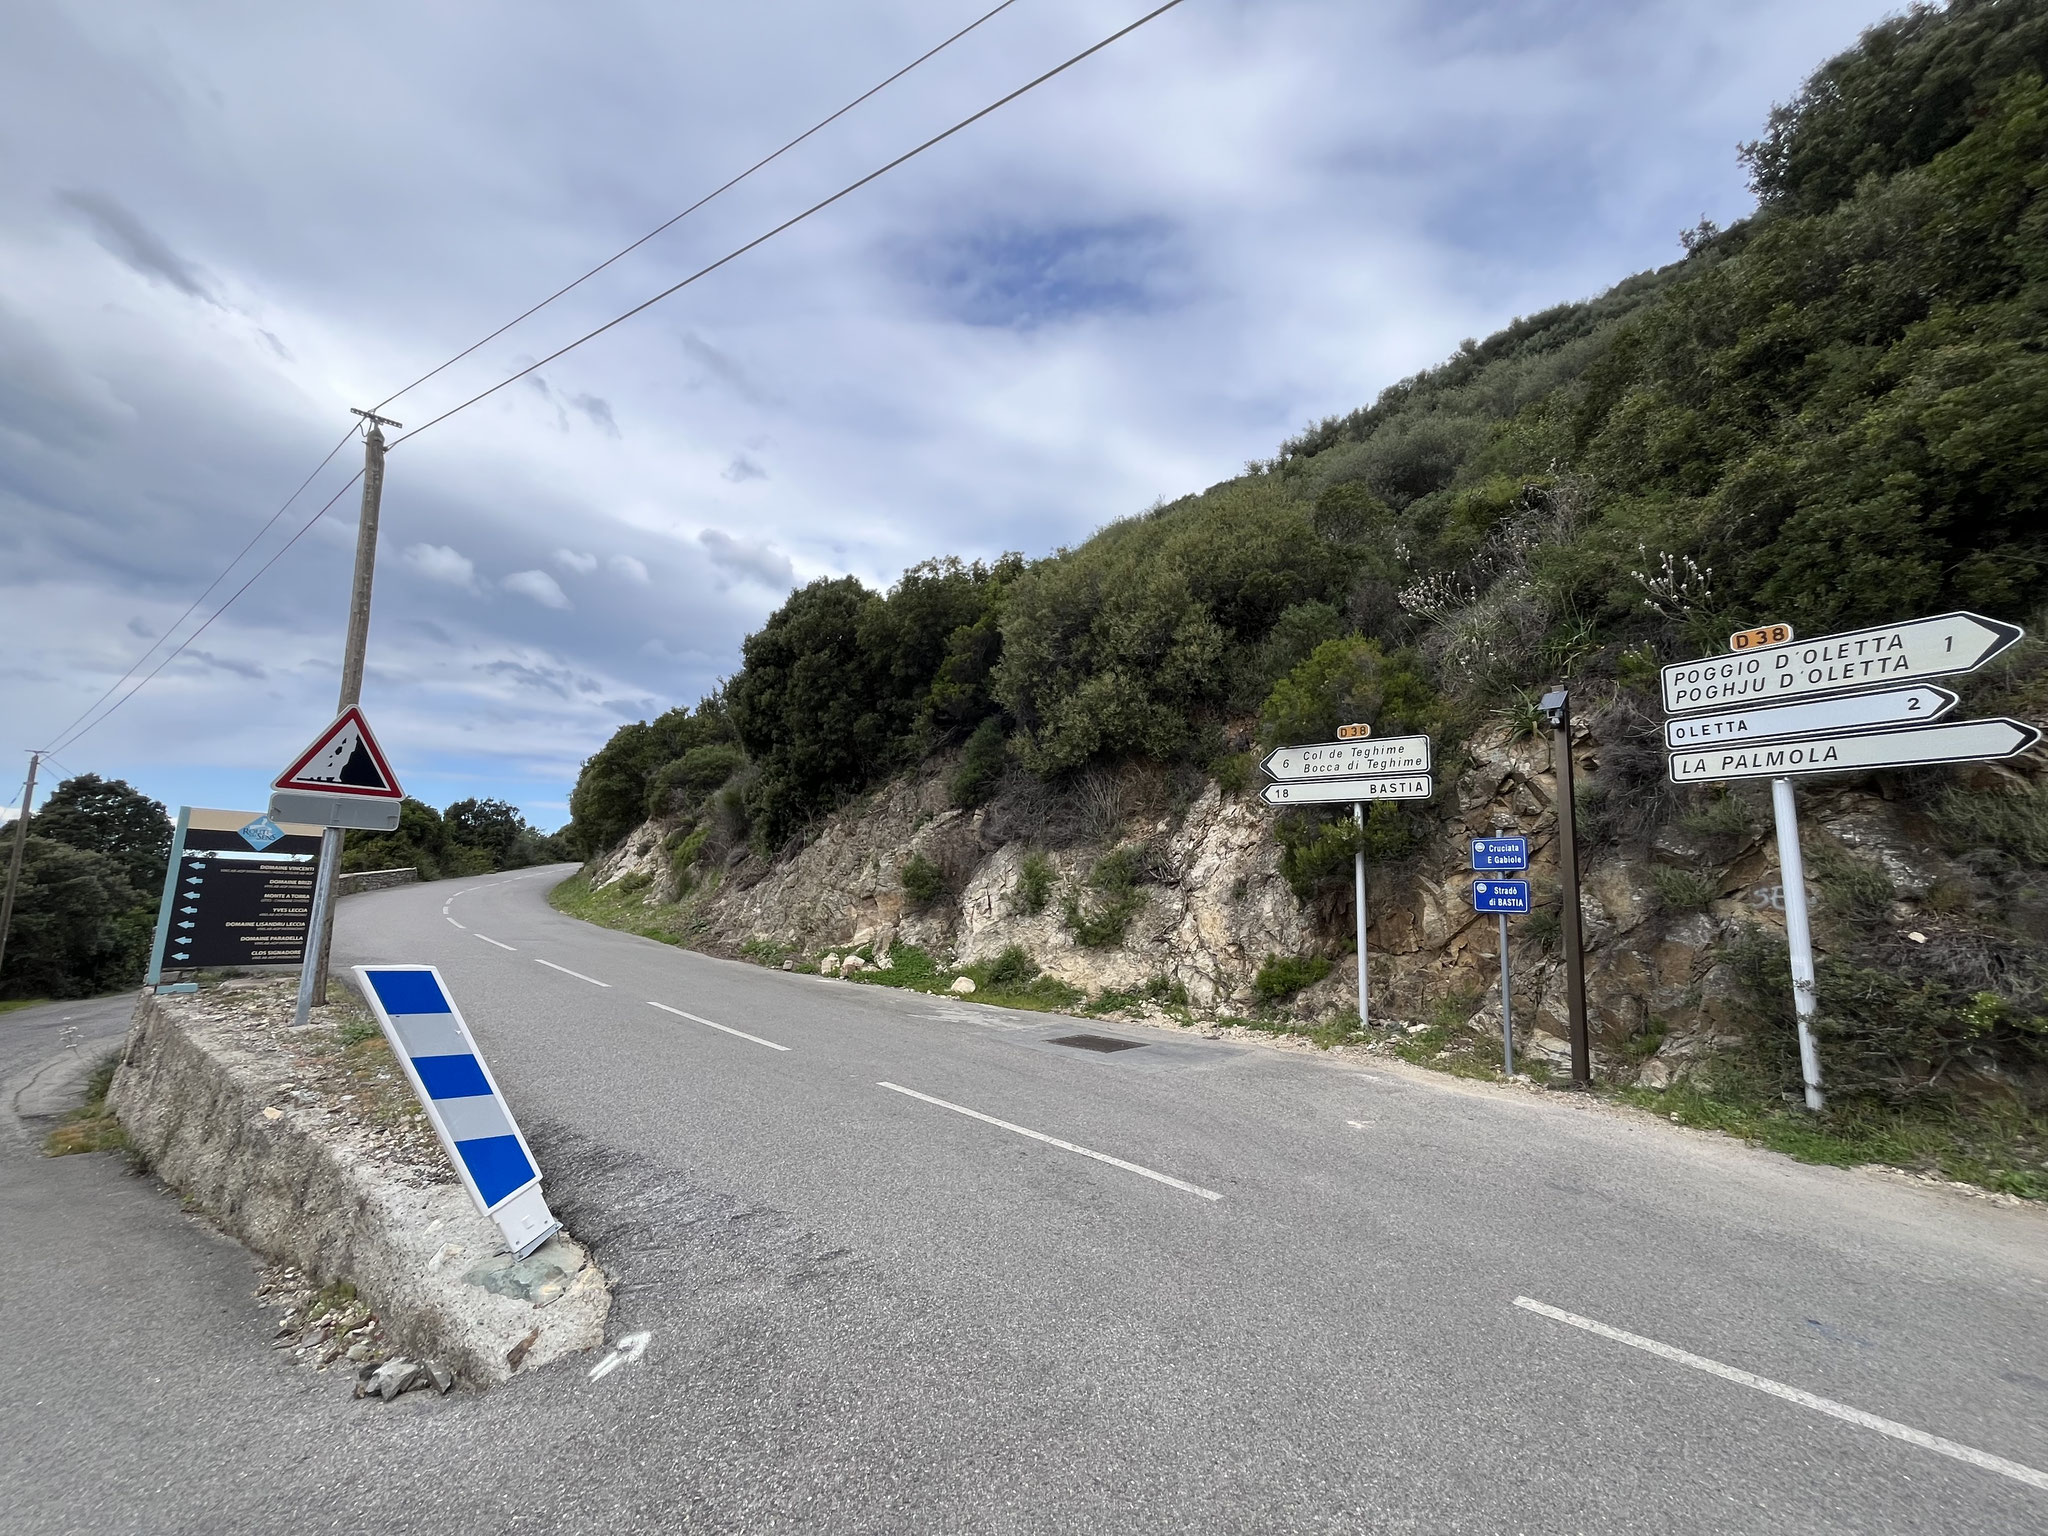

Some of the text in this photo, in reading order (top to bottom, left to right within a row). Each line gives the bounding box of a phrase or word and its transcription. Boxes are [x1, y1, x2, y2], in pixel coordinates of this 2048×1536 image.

[1736, 627, 1785, 649] D 38
[1944, 636, 1953, 652] 1
[1674, 634, 1904, 686] POGGIO D'OLETTA
[1676, 654, 1909, 704] POGHJU D'OLETTA
[1907, 697, 1921, 711] 2
[1340, 726, 1367, 738] D 38
[1676, 719, 1748, 739] OLETTA
[1303, 745, 1405, 761] Col de Teghime
[1682, 746, 1838, 774] LA PALMOLA
[1282, 759, 1290, 769] 6
[1303, 756, 1422, 773] Bocca di Teghime
[1275, 789, 1289, 798] 18
[1370, 781, 1423, 794] BASTIA
[1488, 898, 1524, 906] di BASTIA
